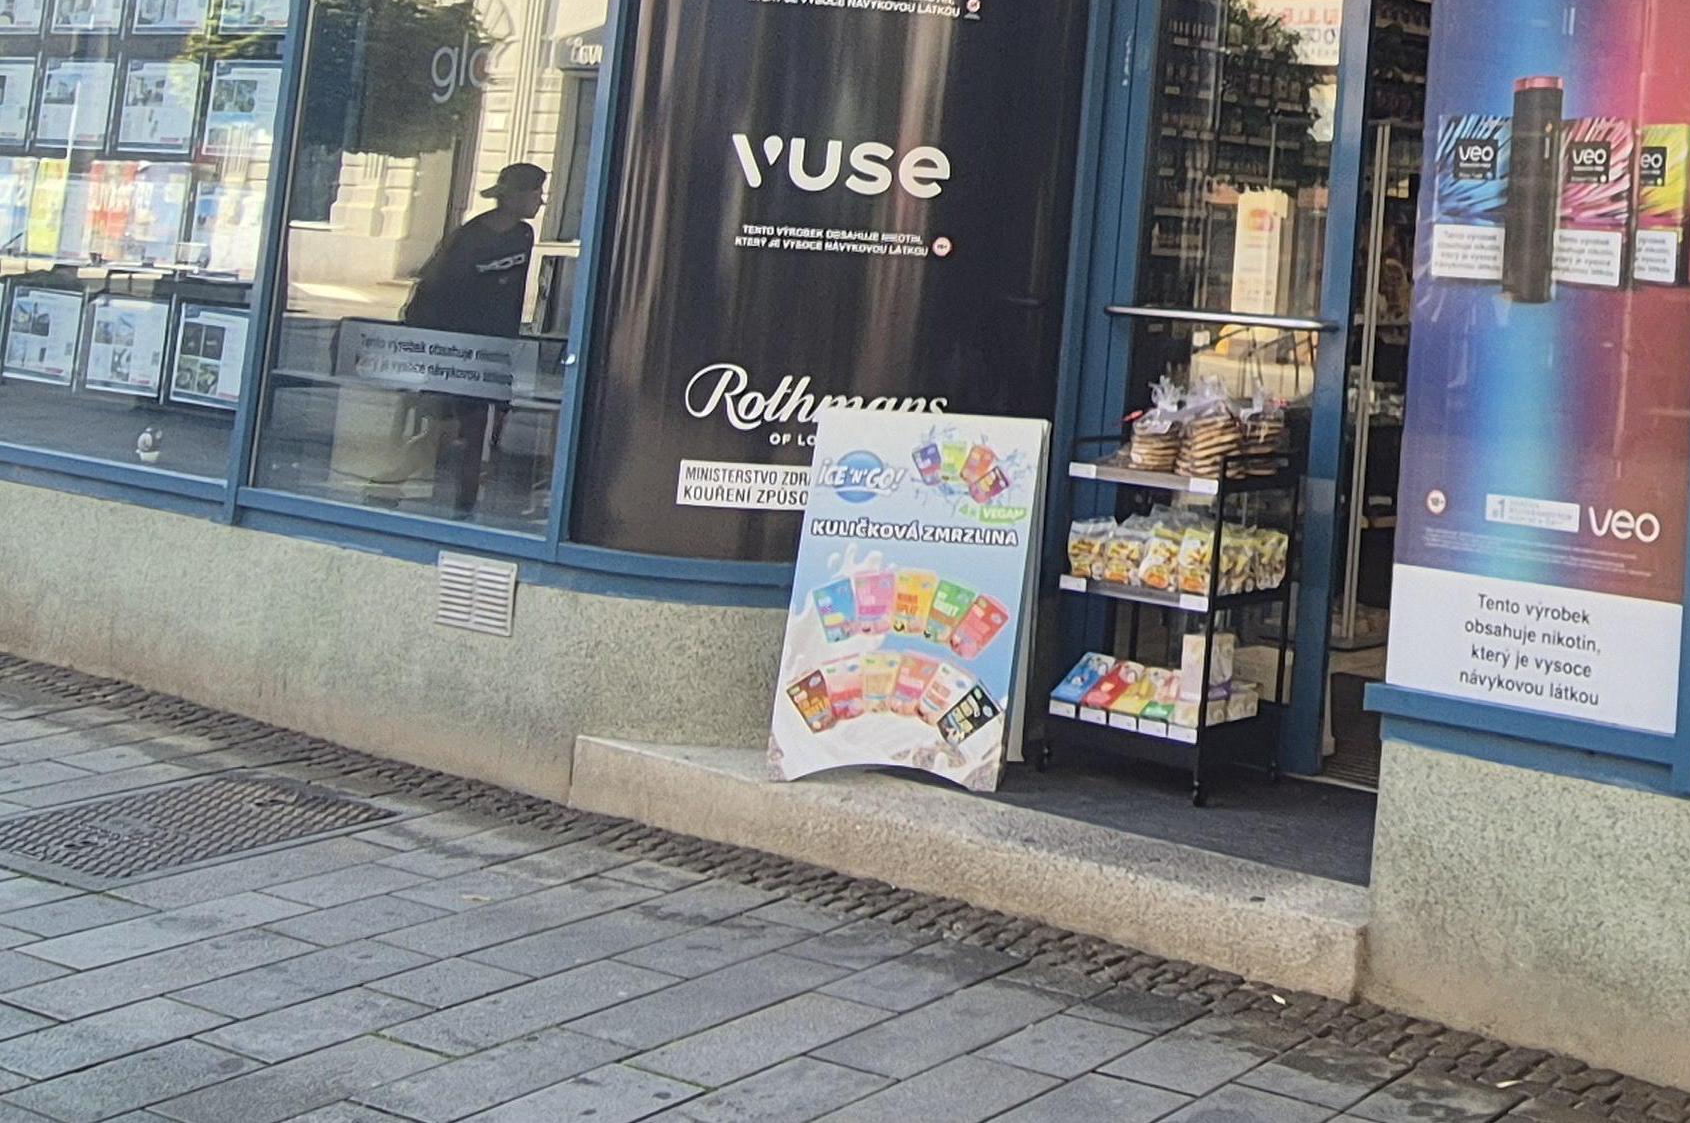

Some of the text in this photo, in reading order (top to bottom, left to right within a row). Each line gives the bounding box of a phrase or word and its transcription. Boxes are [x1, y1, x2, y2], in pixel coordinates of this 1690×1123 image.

[1459, 145, 1494, 162] veo
[1572, 148, 1607, 165] veo
[743, 225, 774, 236] TENTO
[769, 432, 791, 446] OF
[685, 466, 778, 485] MINISTERSTVO
[683, 484, 751, 504] KOUŘENÍ
[811, 517, 1019, 546] KULIČKOVÁ ZMRZLINA
[1588, 505, 1660, 543] veo
[1478, 593, 1590, 626] Tento výrobek
[1464, 619, 1601, 654] obsahuje nikotin,
[1471, 644, 1592, 678] který je vysoce
[1459, 669, 1599, 706] návykovou látkou
